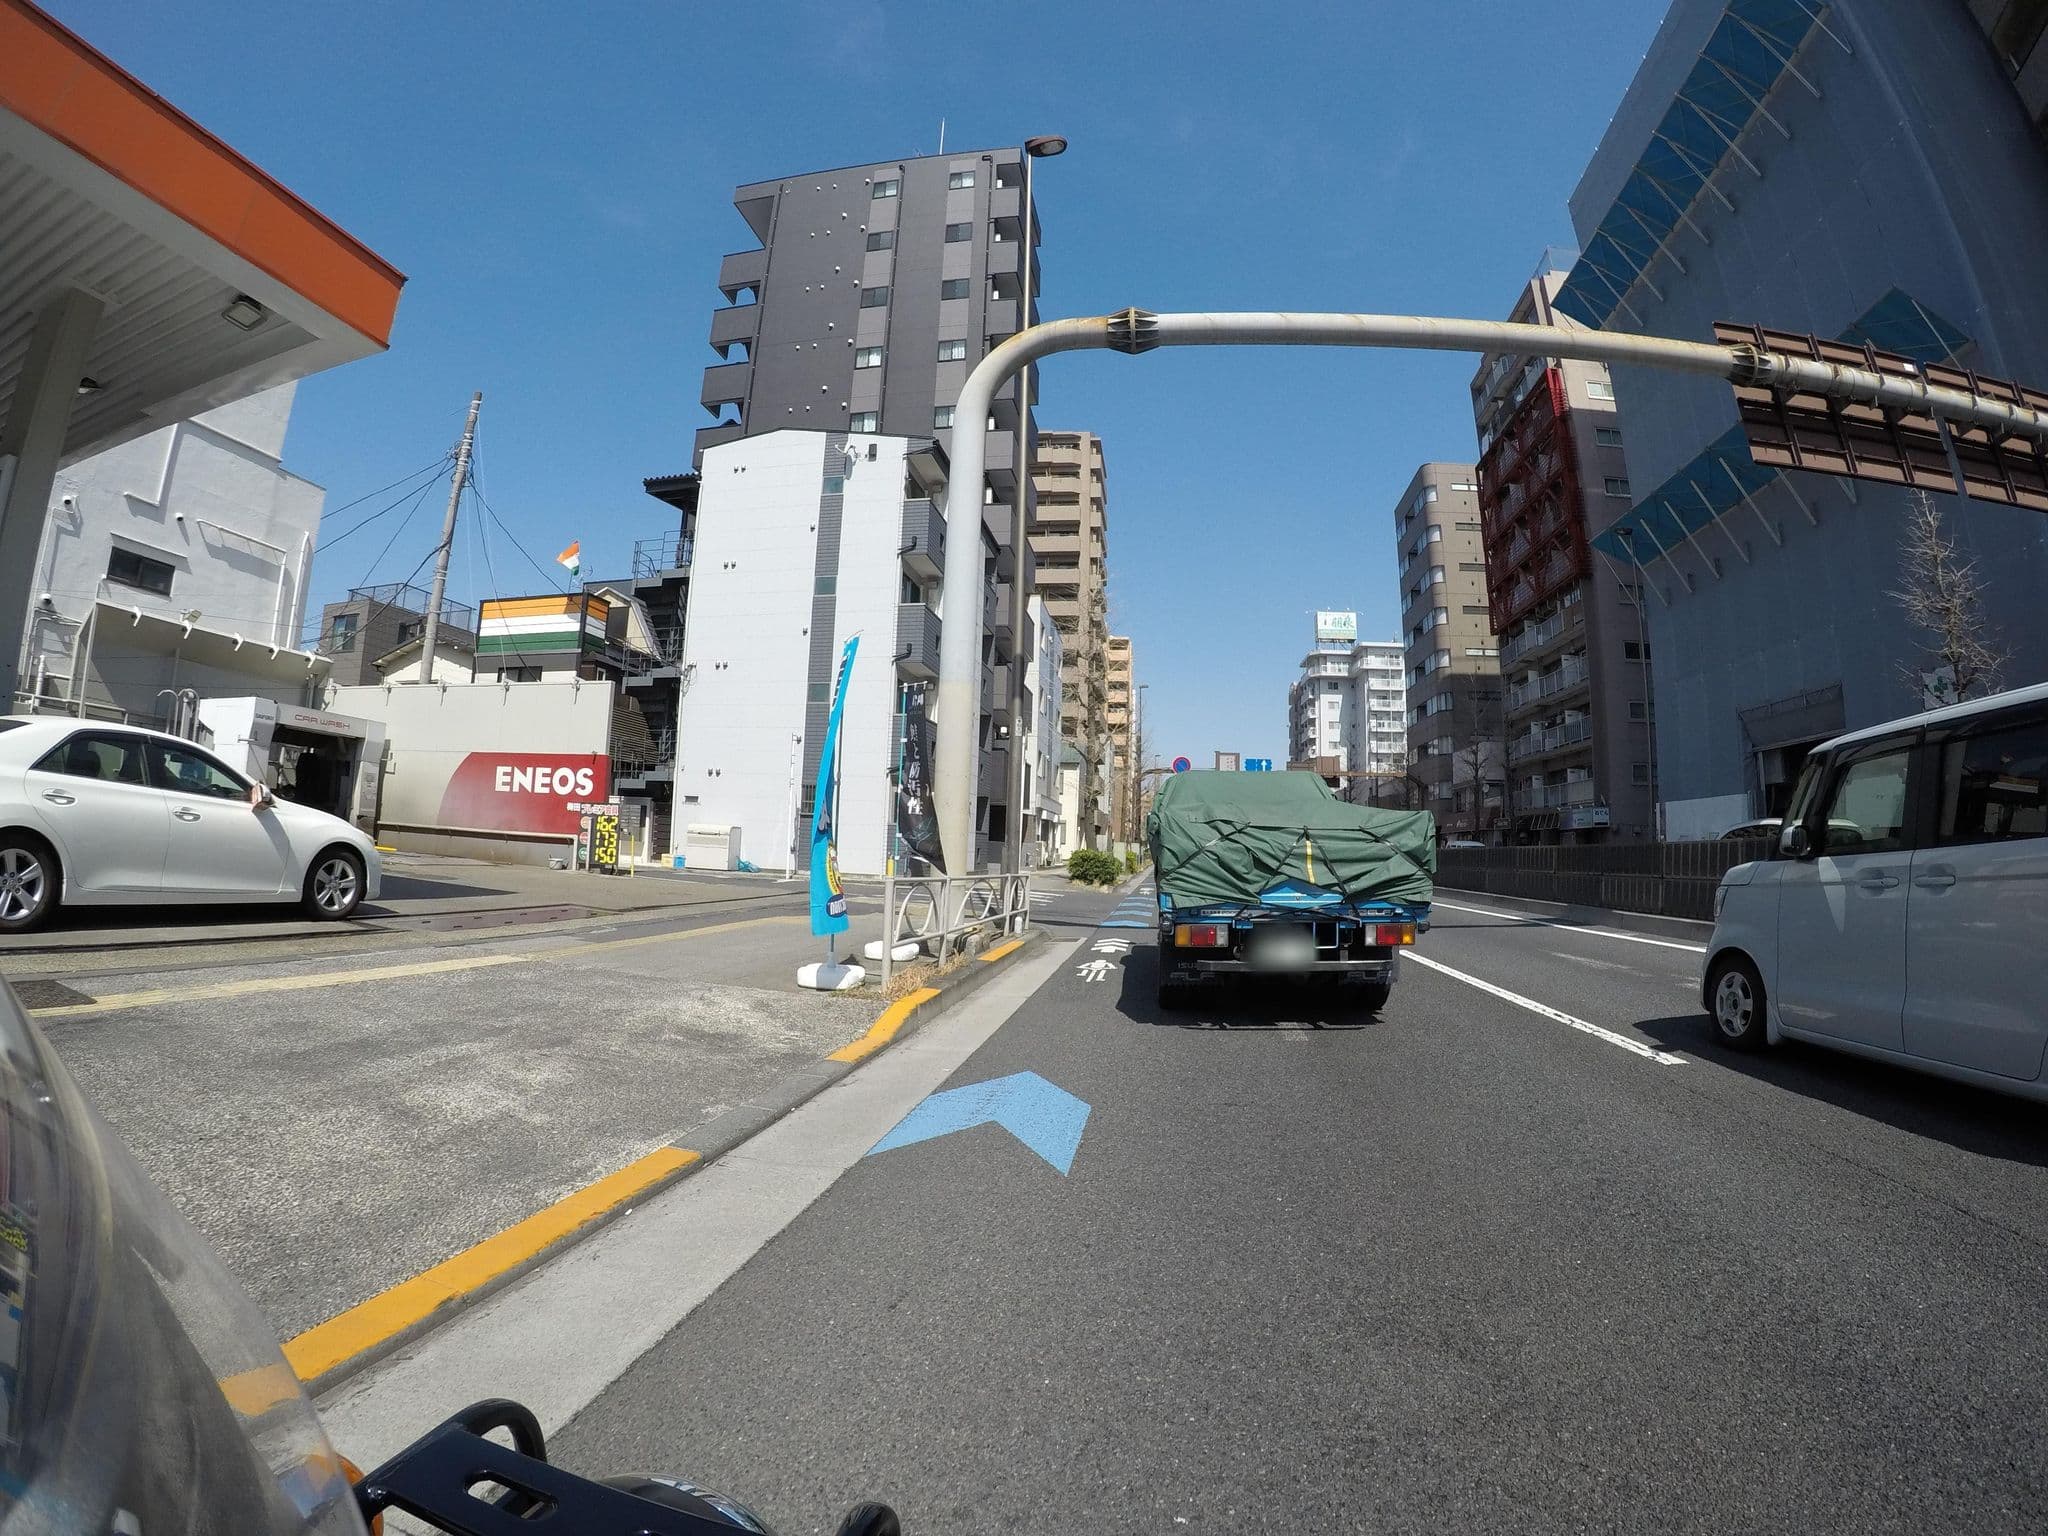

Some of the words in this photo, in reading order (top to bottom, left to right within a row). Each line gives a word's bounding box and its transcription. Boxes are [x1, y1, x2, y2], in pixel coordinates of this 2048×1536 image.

[294, 714, 319, 724] CAR
[319, 719, 351, 730] WASH
[495, 765, 594, 796] ENEOS
[597, 815, 618, 832] 162
[595, 831, 617, 848] 173
[594, 847, 616, 864] 150
